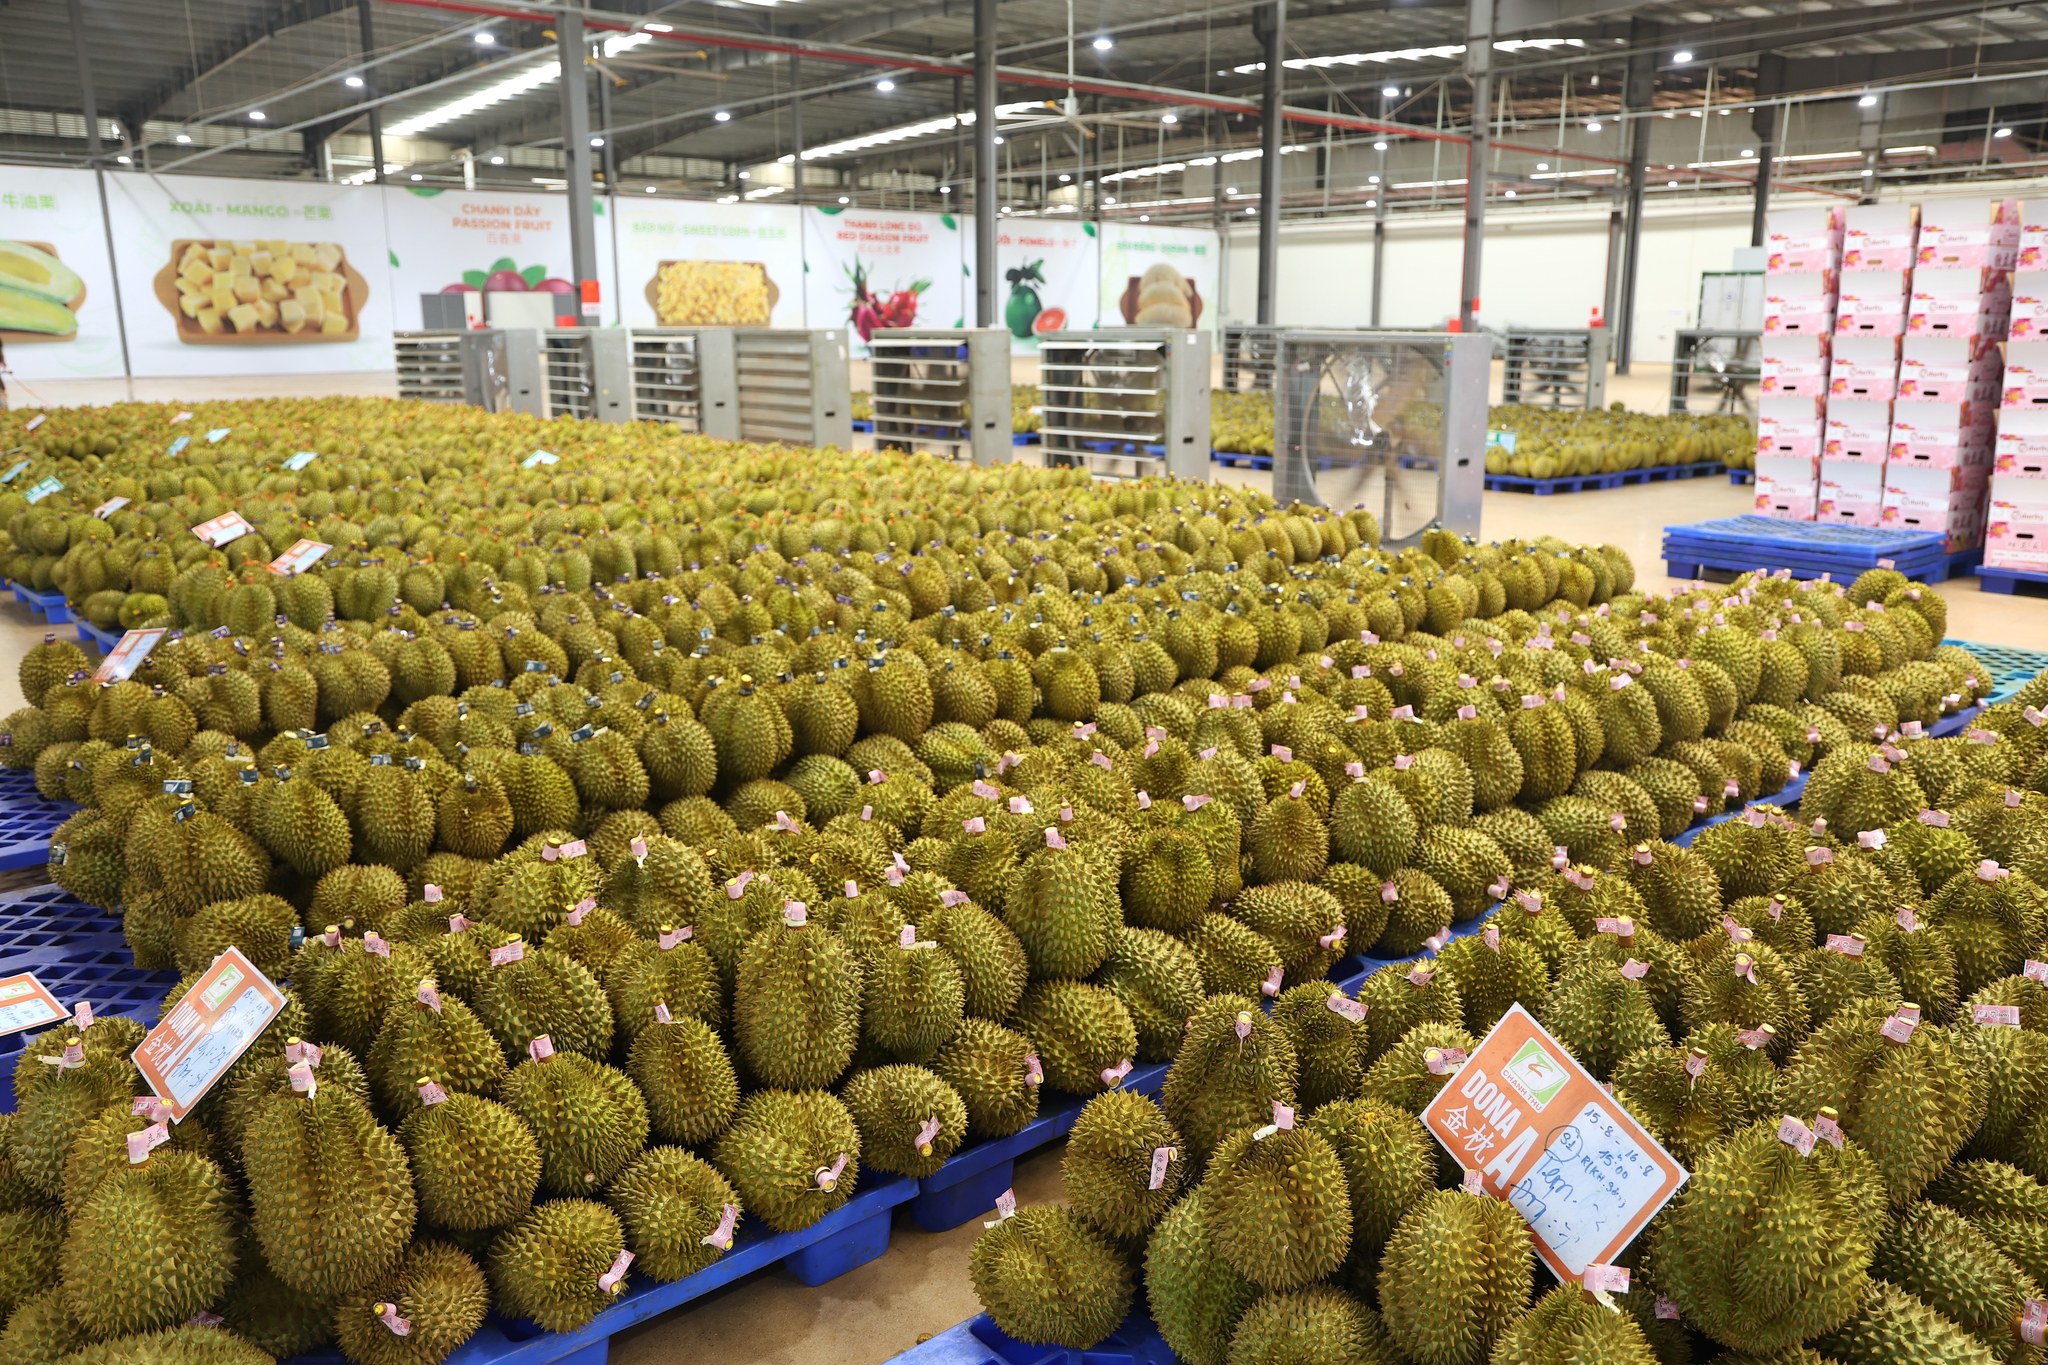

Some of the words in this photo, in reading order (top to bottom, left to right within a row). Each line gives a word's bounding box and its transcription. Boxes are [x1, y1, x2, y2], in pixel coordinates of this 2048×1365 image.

[2, 192, 55, 209] 牛油果
[226, 204, 289, 218] MANGO
[461, 204, 511, 215] CHANH
[452, 217, 511, 229] PASSION
[515, 219, 553, 231] FRUIT
[837, 231, 857, 240] RED
[859, 232, 900, 241] DRAGON
[167, 1001, 202, 1040] DONA
[157, 1022, 206, 1077] A
[1460, 1068, 1522, 1140] DONA
[1502, 1069, 1528, 1097] CHANH
[1527, 1094, 1543, 1112] THU
[1440, 1104, 1495, 1165] 金枕
[1482, 1125, 1539, 1190] A
